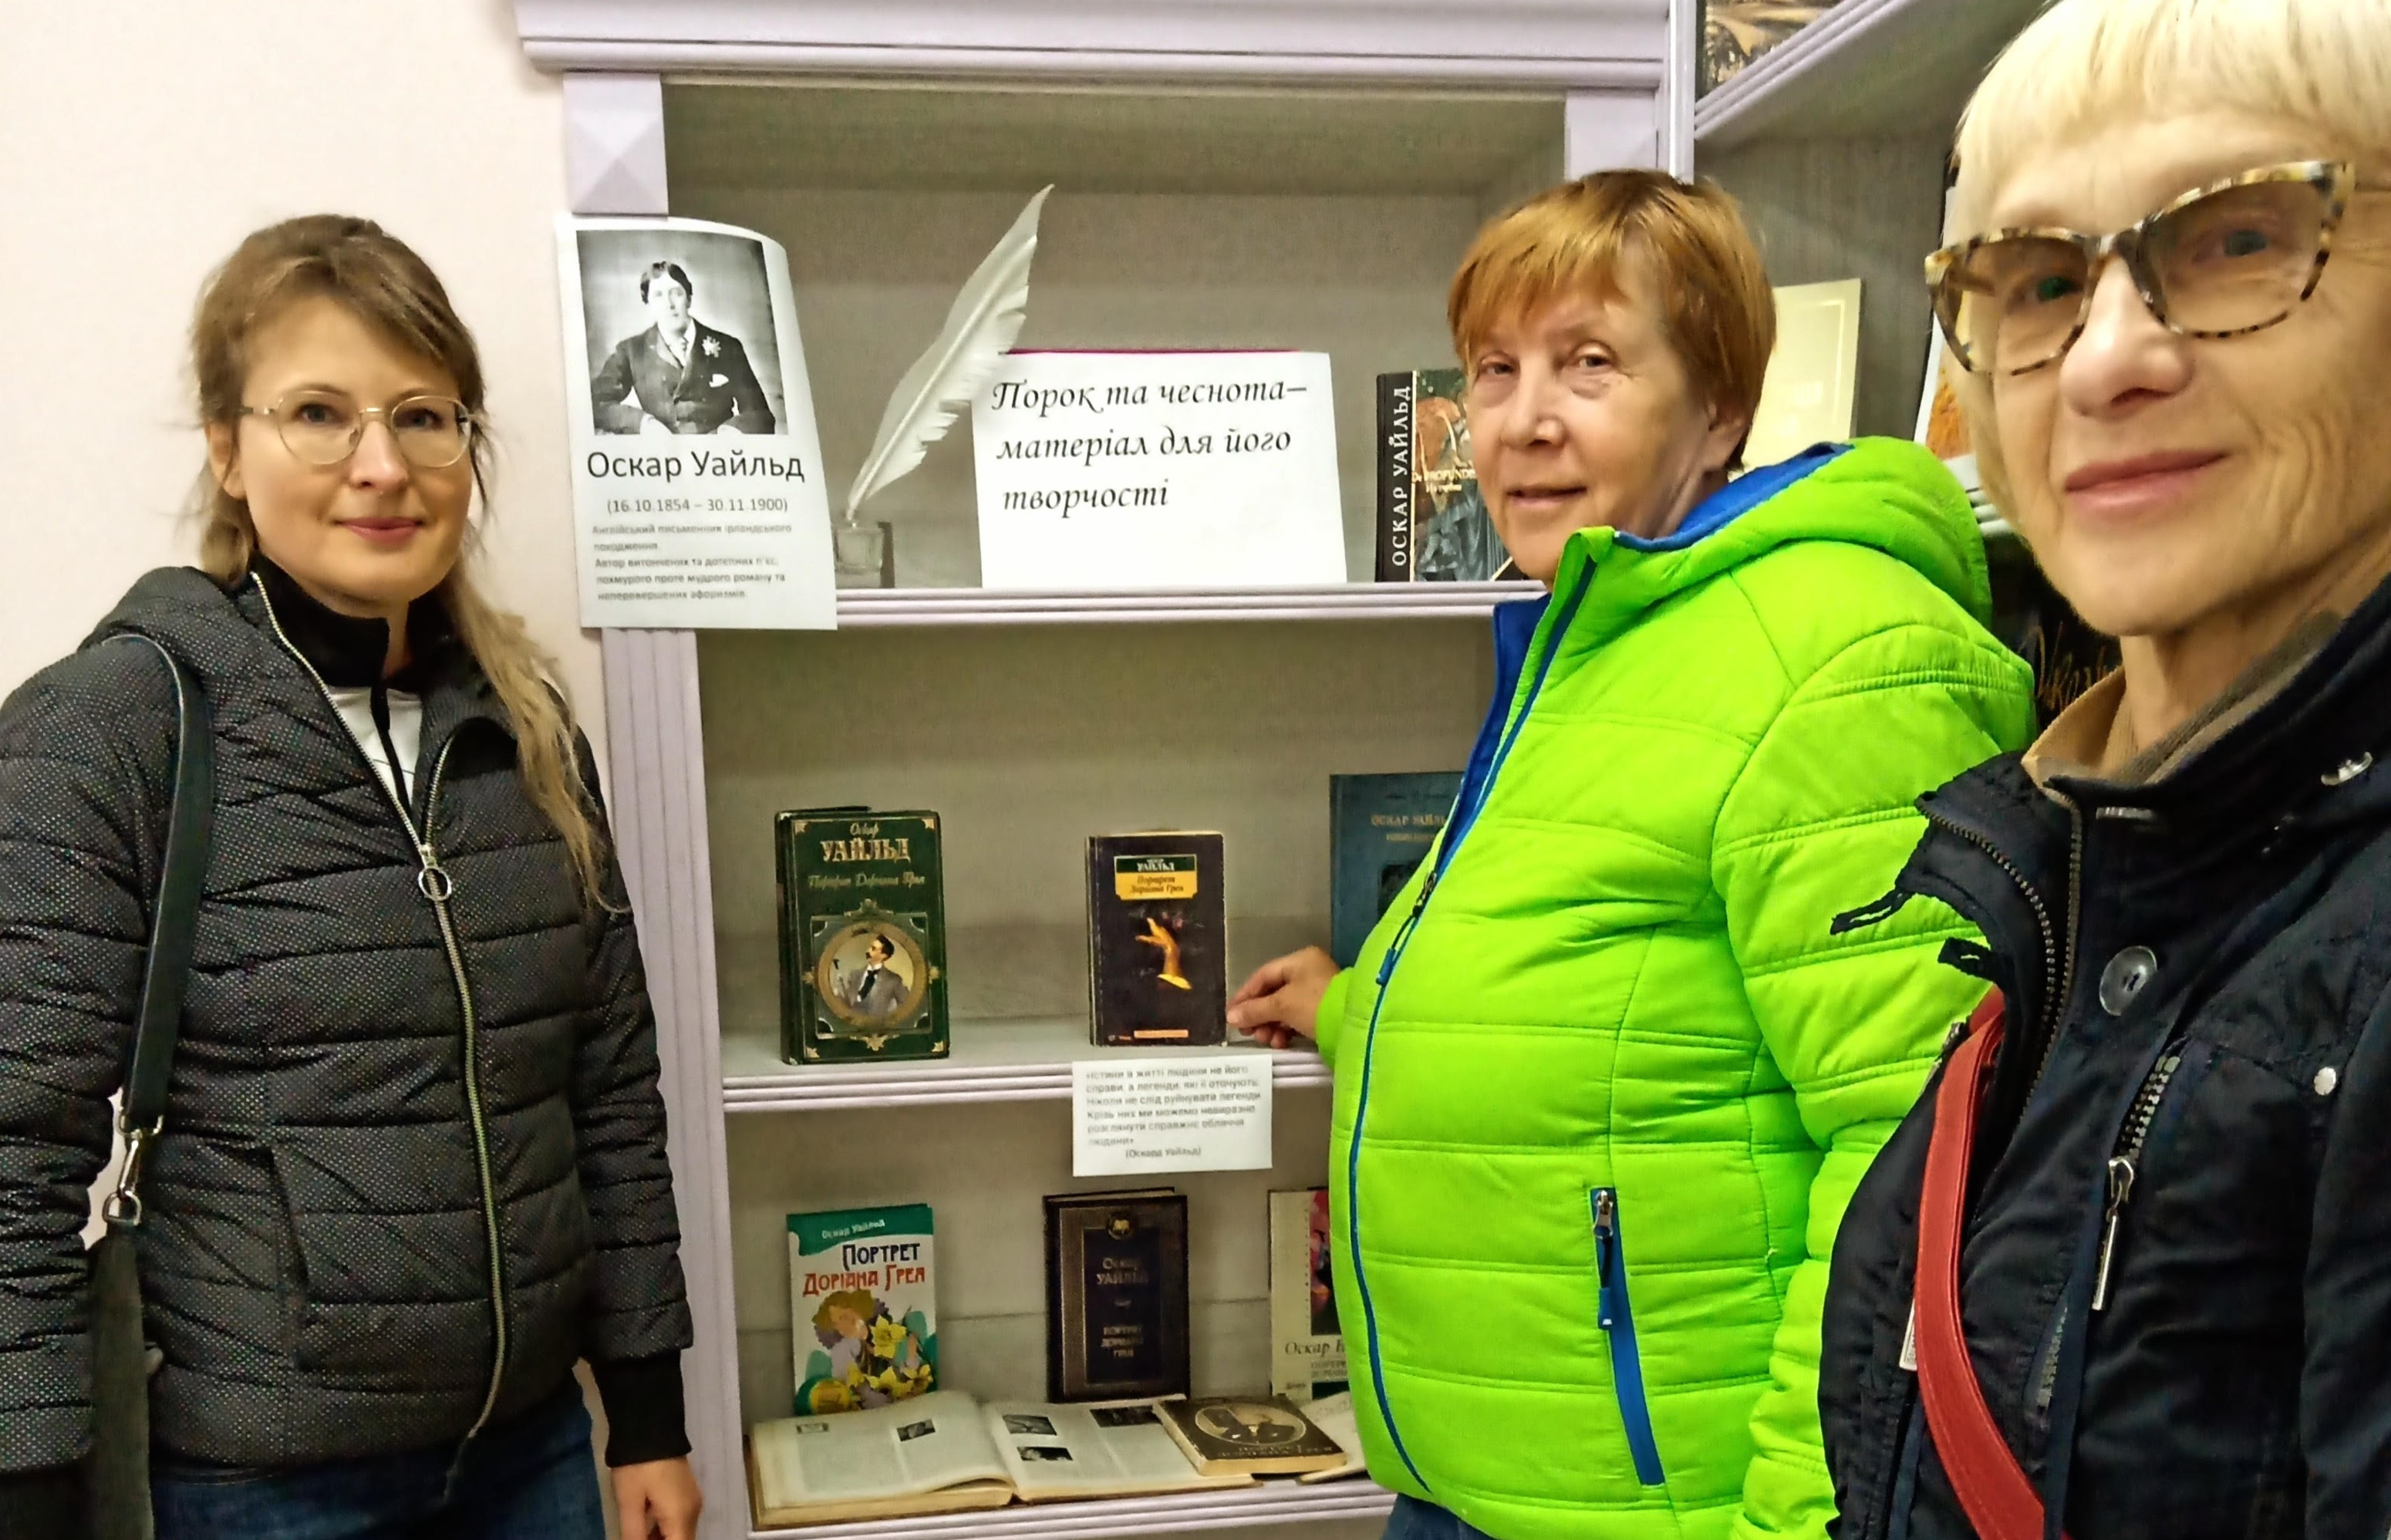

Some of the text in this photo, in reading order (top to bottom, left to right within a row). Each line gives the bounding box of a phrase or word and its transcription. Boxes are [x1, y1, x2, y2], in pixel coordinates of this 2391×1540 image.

[991, 379, 1104, 417] Порок
[1107, 384, 1147, 405] та
[996, 425, 1291, 466] матеріал для його
[587, 450, 805, 484] Оскар Уайльд
[1388, 386, 1411, 567] ОСКАР УАЙЛЬД
[1003, 478, 1169, 518] творчості
[595, 558, 626, 568] Автор
[597, 576, 653, 585] похмурого
[687, 575, 731, 584] мудрого
[733, 574, 772, 584] роману
[774, 574, 786, 582] та
[820, 837, 911, 863] УАЙЛЬД
[1225, 1065, 1248, 1074] його
[1140, 1095, 1162, 1105] слід
[842, 1242, 920, 1272] ПОРТРЕТ
[803, 1264, 925, 1296] ДОРІАНА ГРЕЯ
[1285, 1341, 1330, 1357] Оскар
